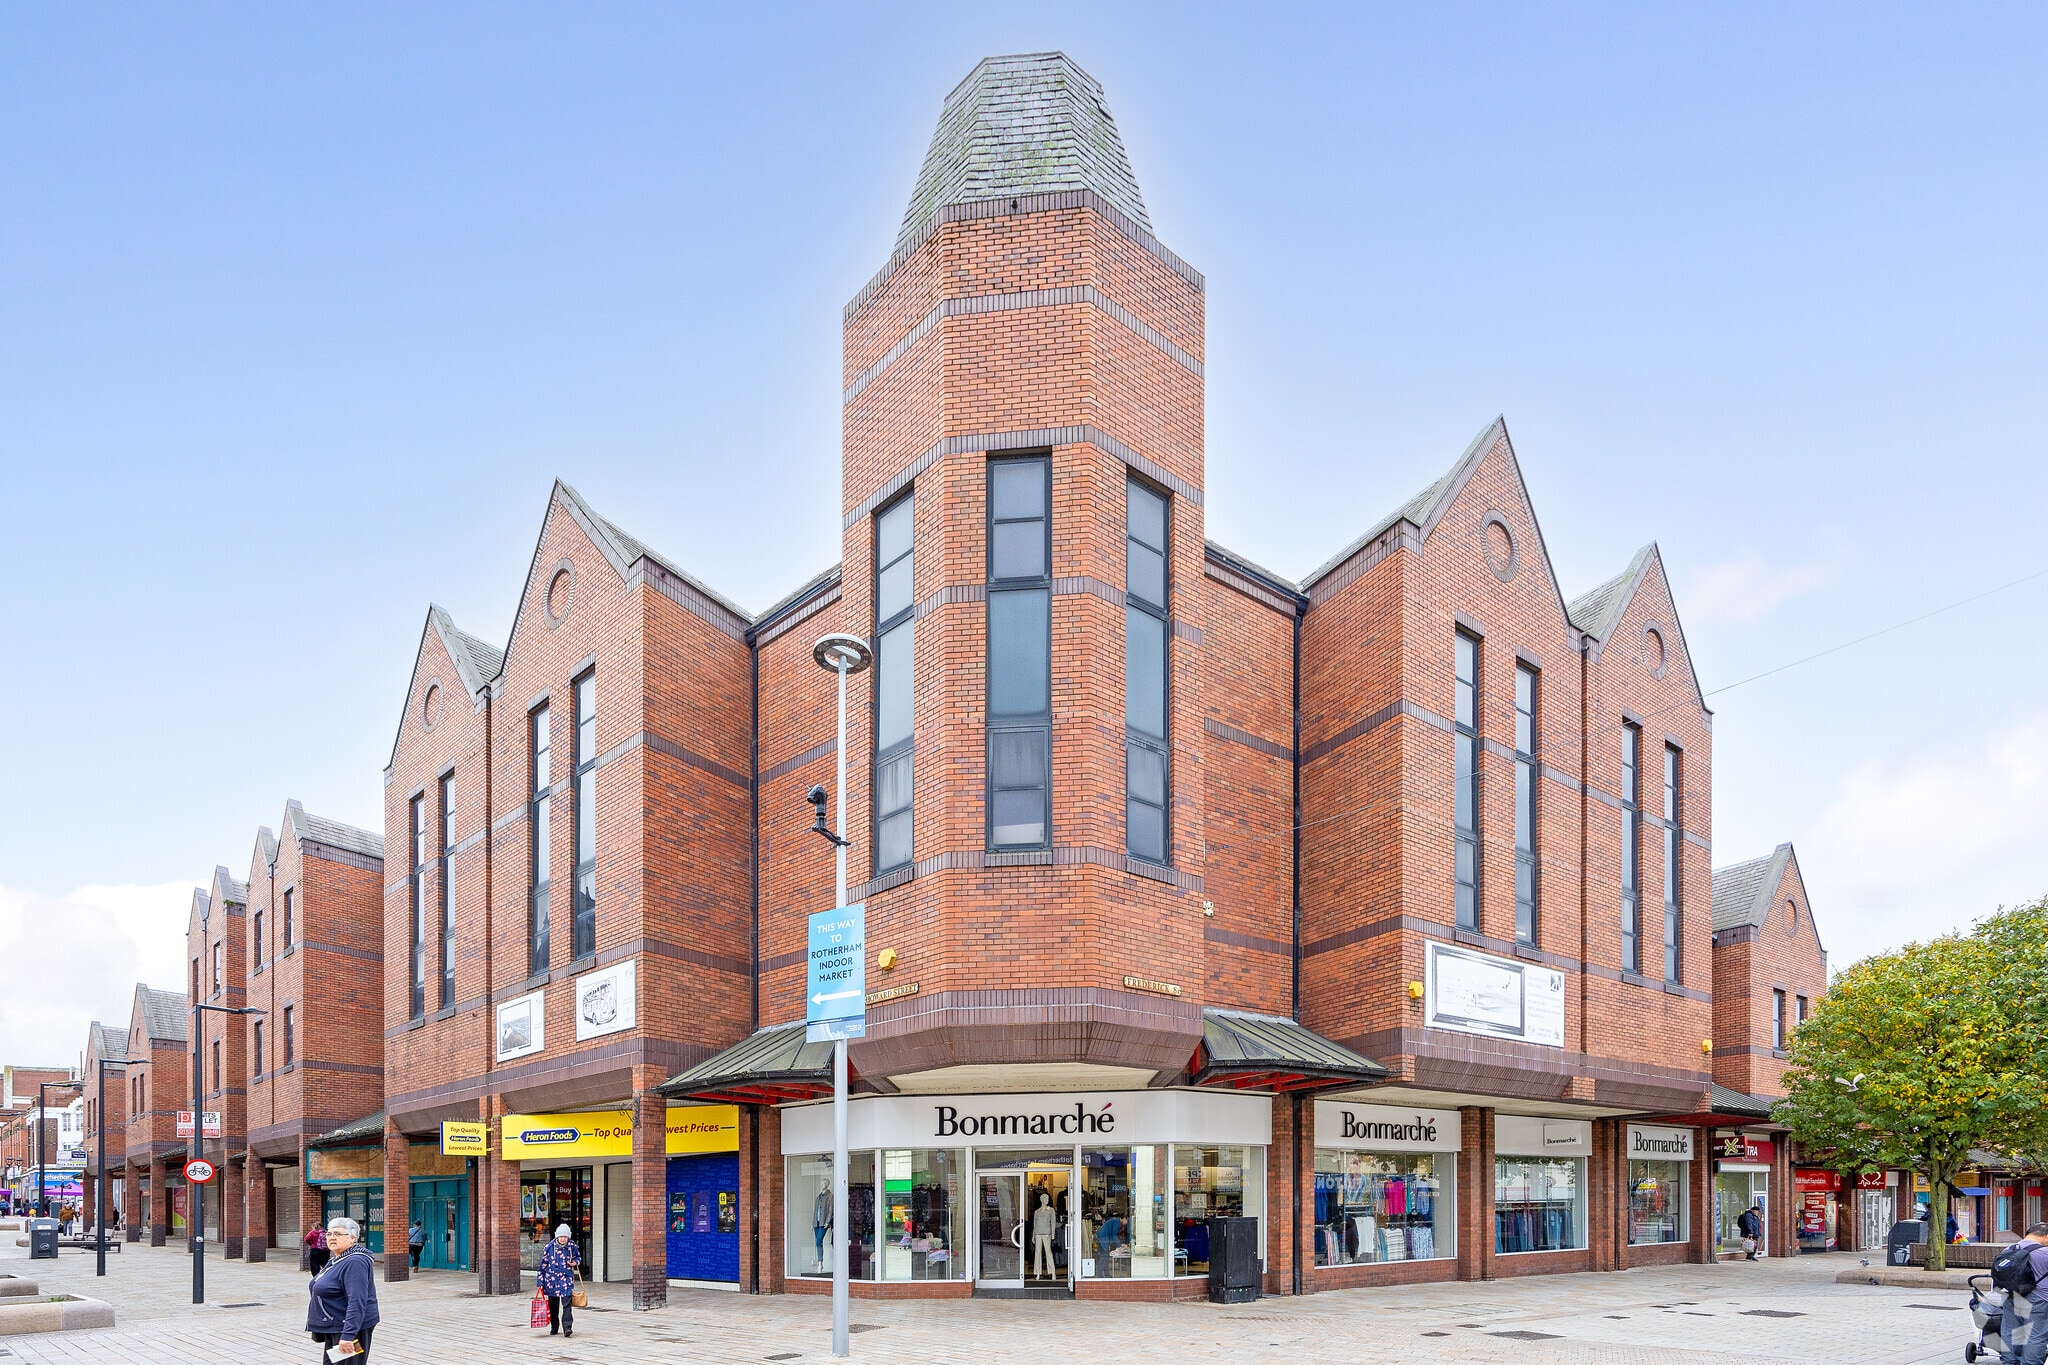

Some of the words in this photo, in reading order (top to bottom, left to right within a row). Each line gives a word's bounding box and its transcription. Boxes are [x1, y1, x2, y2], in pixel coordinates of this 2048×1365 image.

[817, 923, 835, 934] THIS
[837, 918, 856, 930] WAY
[830, 933, 842, 944] TO
[811, 943, 862, 959] ROTHERHAM
[819, 956, 853, 970] INDOOR
[819, 969, 853, 982] MARKET
[893, 984, 917, 997] STREET
[1127, 978, 1169, 992] FREDERICK
[934, 1102, 1115, 1137] Bonmarché
[1340, 1110, 1437, 1143] Bonmarché
[525, 1132, 549, 1141] Heron
[549, 1131, 573, 1140] Foods
[594, 1128, 610, 1139] Top
[613, 1127, 632, 1138] Qua
[666, 1124, 688, 1134] west
[690, 1122, 719, 1133] Prices
[1633, 1131, 1688, 1154] Bonmarché
[1747, 1145, 1758, 1156] TRA
[559, 1186, 572, 1194] Buy
[369, 1208, 384, 1222] SORR
